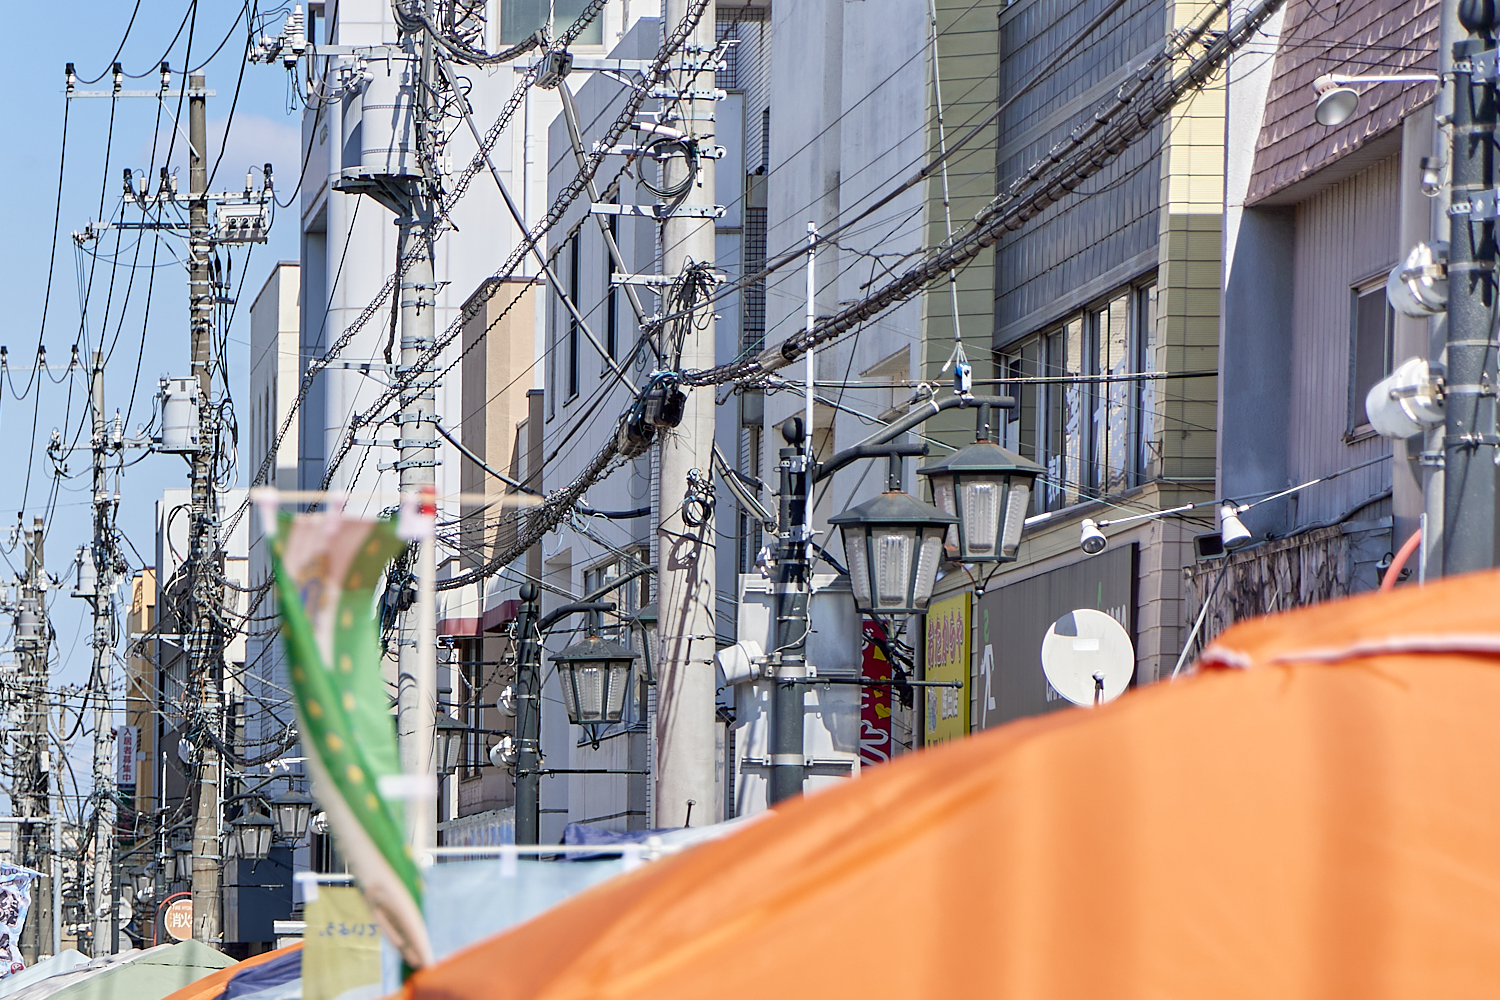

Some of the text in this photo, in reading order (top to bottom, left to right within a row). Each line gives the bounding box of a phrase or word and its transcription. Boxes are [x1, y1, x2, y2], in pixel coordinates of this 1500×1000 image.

[122, 727, 132, 782] 入居者募集中
